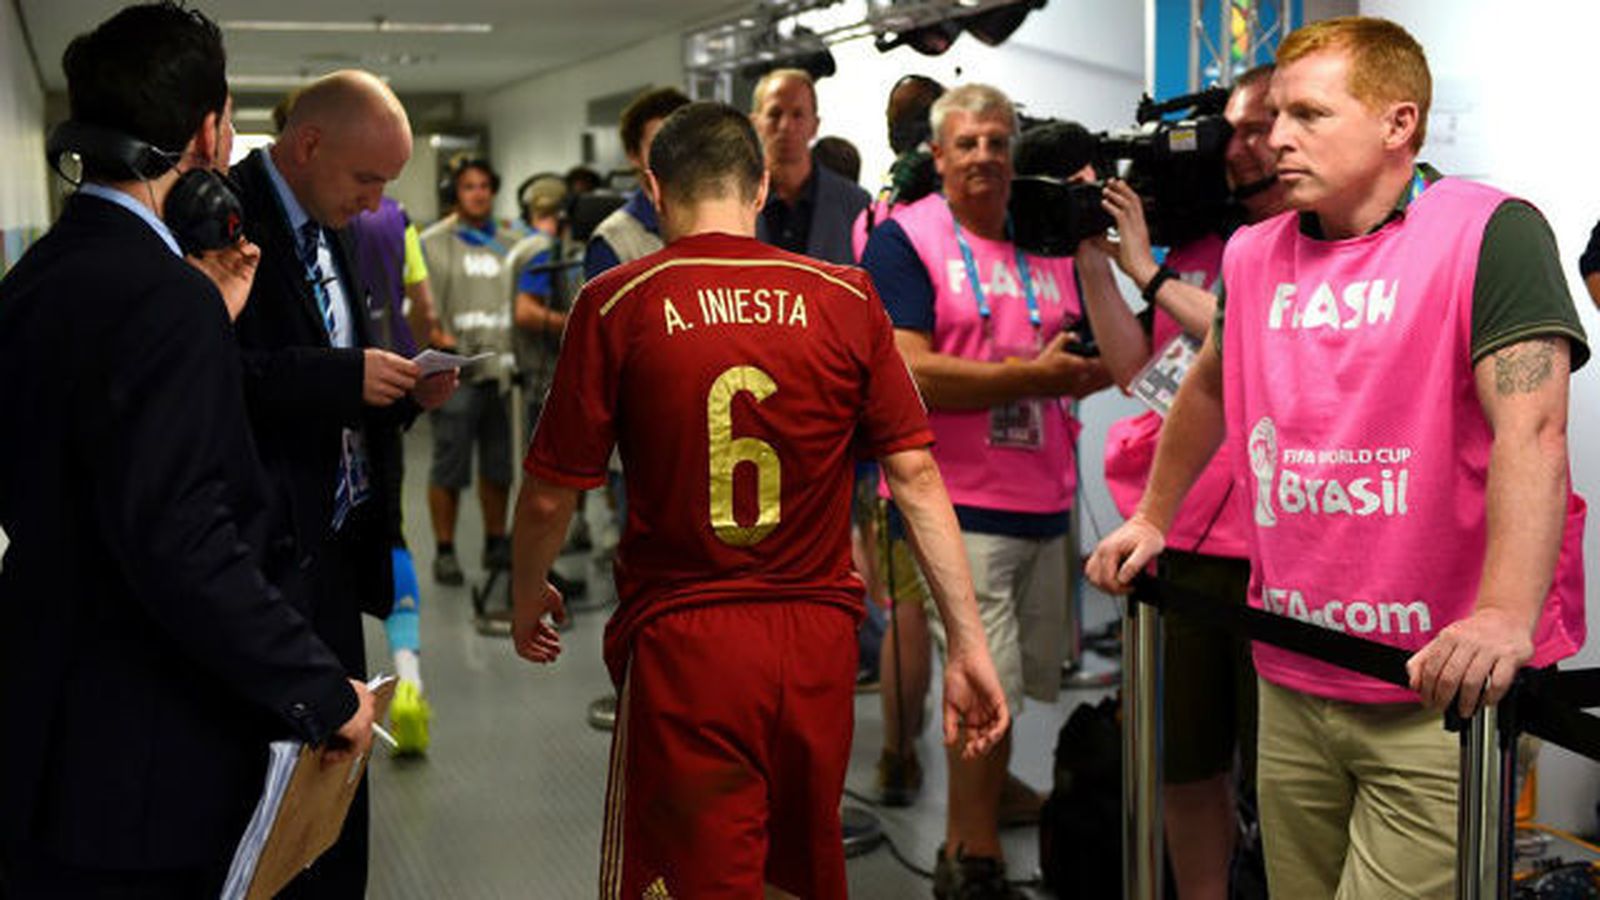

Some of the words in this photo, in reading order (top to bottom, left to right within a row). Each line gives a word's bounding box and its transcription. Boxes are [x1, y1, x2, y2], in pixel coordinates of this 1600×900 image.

[664, 298, 694, 335] A.
[697, 288, 808, 329] INIESTA
[707, 365, 781, 546] 6
[1282, 448, 1316, 464] FIFA
[1374, 447, 1411, 464] CUP
[1278, 468, 1409, 516] Brasil
